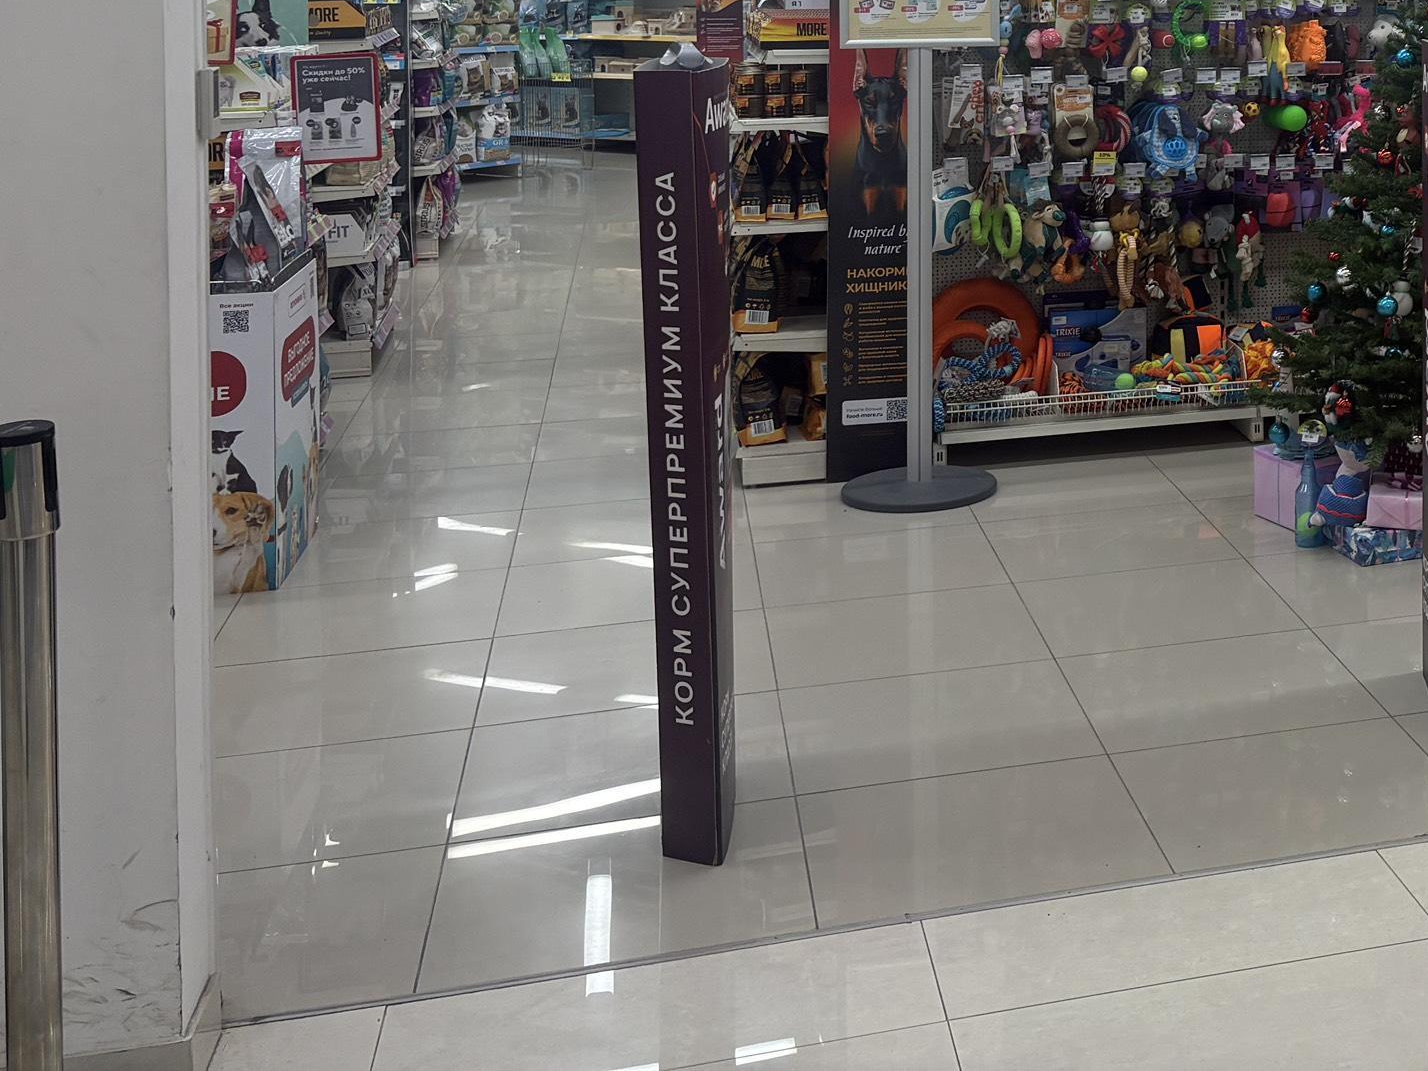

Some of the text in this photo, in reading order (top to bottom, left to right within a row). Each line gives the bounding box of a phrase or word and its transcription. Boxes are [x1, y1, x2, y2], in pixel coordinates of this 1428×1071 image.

[796, 22, 828, 37] MORE
[302, 69, 334, 77] Скидки
[347, 67, 366, 75] 50%
[847, 224, 895, 245] Inspired
[864, 244, 902, 255] nature
[1055, 328, 1080, 337] TRIXIE
[655, 171, 695, 726] КОРМ СУПЕРПРЕМИУМ КЛАССА
